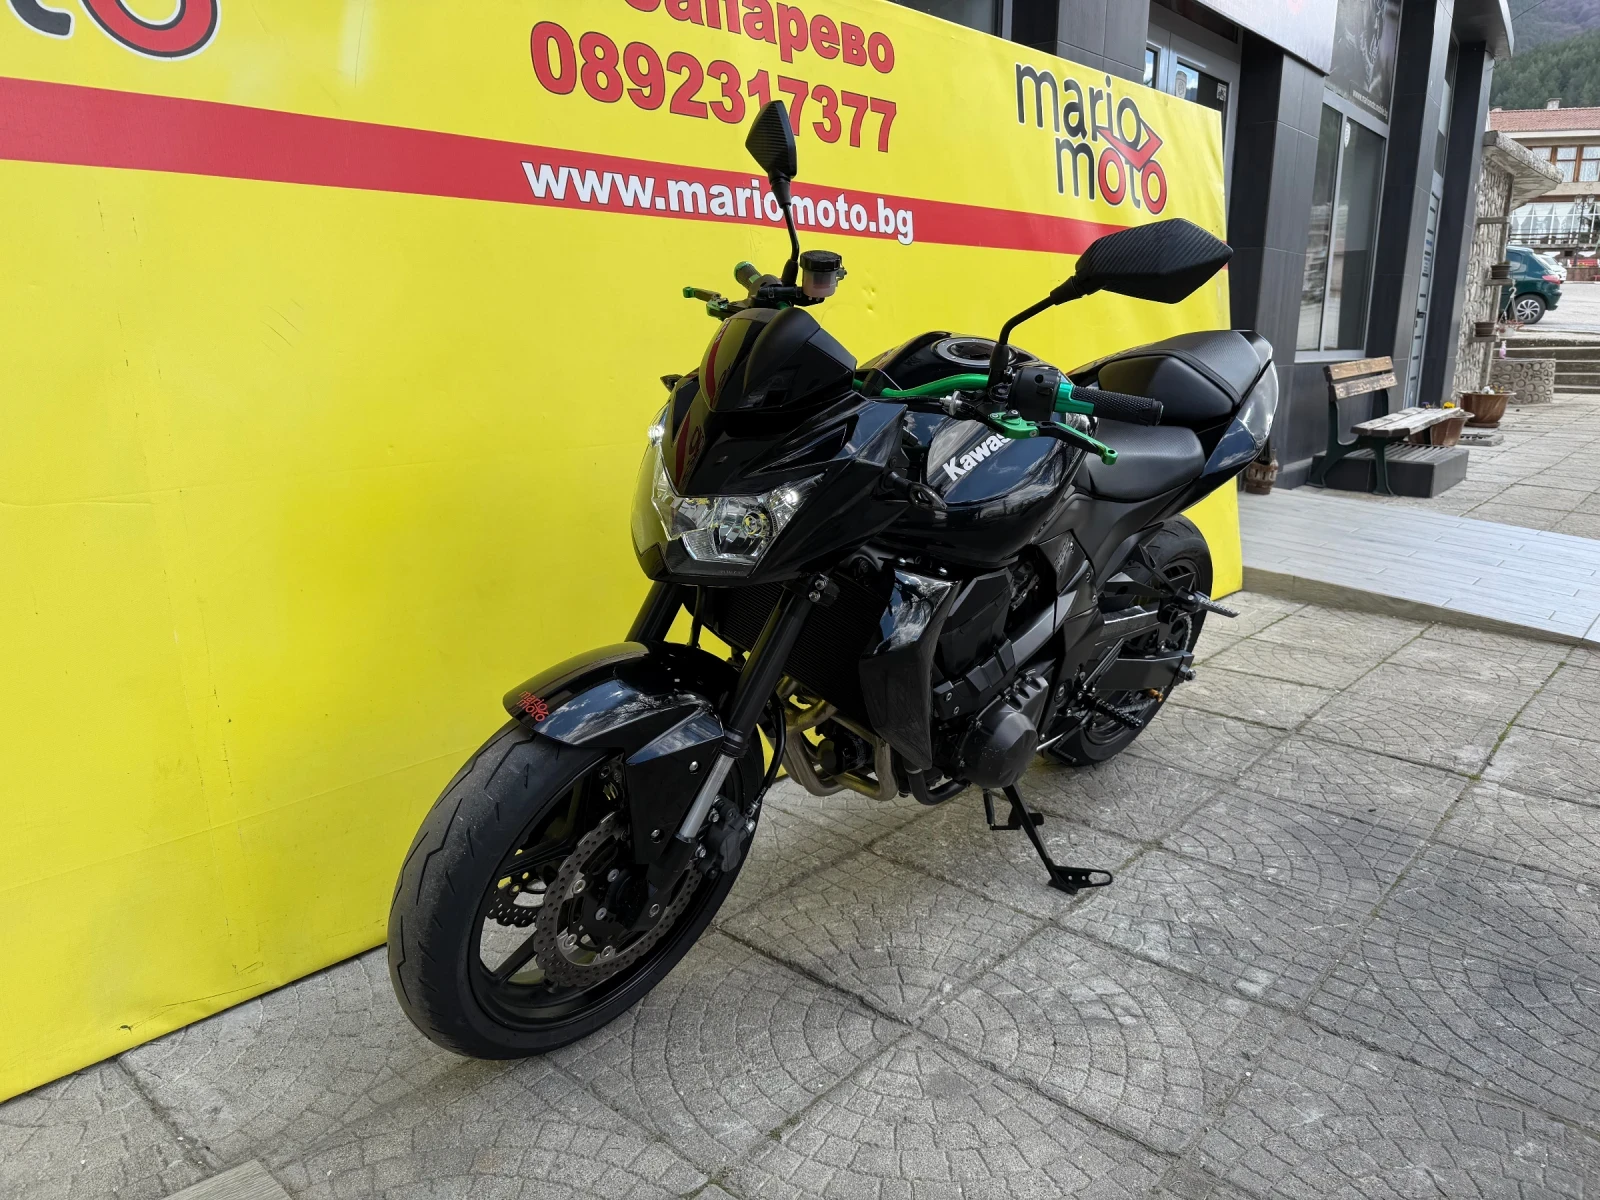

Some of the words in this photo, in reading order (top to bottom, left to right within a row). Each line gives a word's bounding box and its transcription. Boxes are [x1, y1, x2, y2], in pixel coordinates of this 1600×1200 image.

[624, 0, 895, 74] апарево
[530, 21, 897, 153] 0892317377
[1014, 62, 1143, 150] mario
[521, 161, 914, 245] www.mariomoto.bg
[1055, 136, 1168, 215] moto
[516, 699, 546, 721] moto
[519, 690, 548, 711] mario
